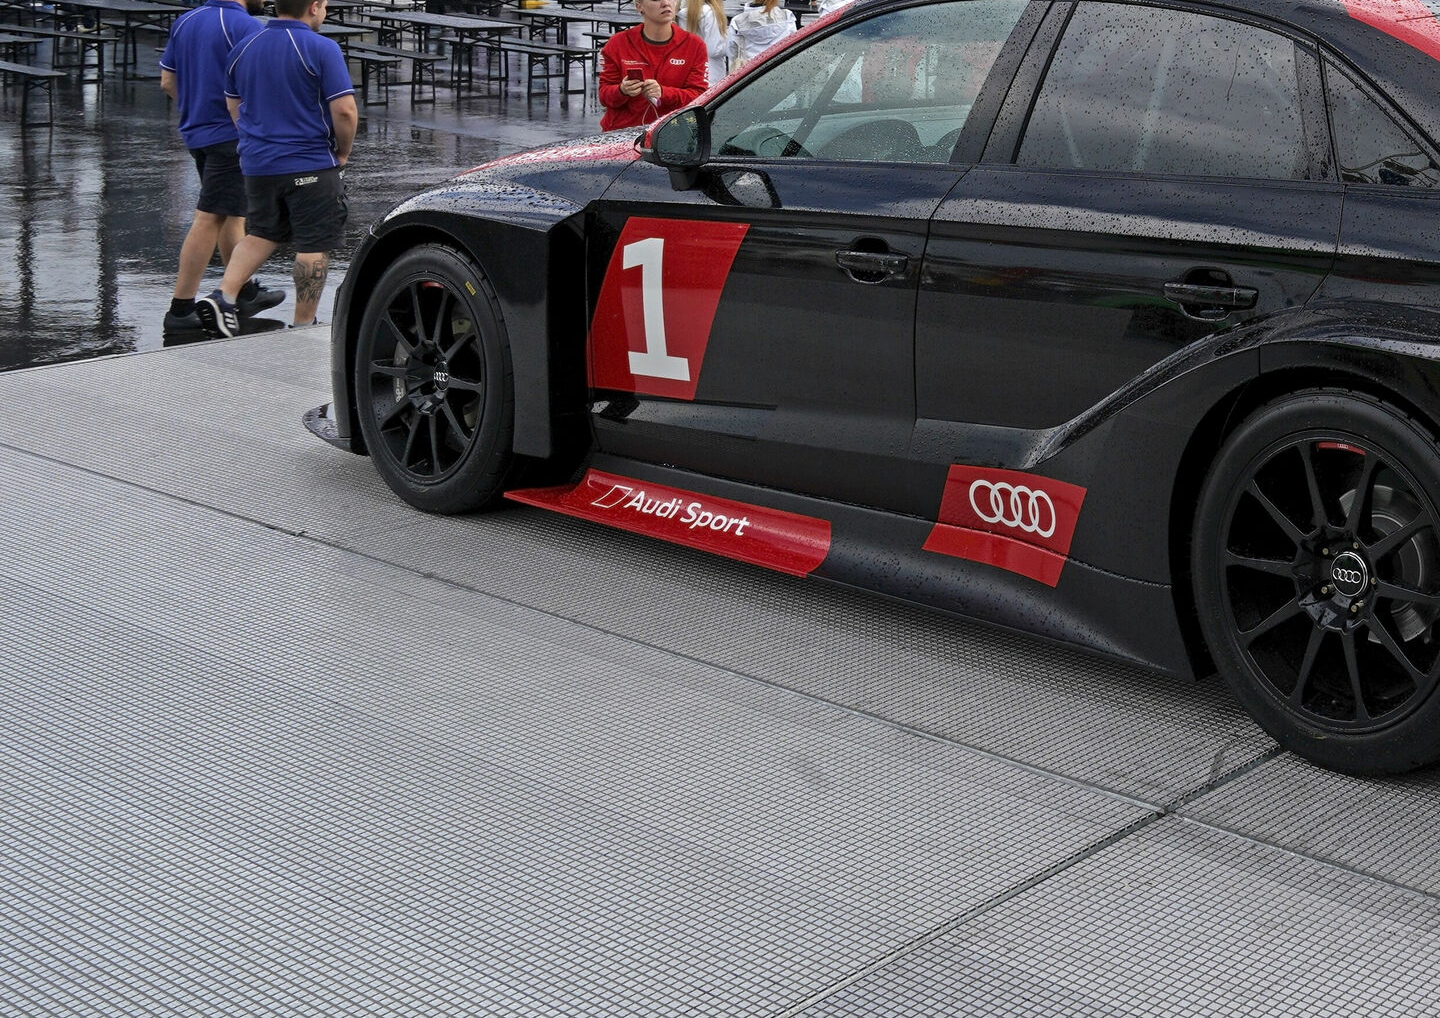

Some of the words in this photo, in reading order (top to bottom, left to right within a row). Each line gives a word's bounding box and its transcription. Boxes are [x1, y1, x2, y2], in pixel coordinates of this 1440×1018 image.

[622, 237, 691, 382] 1
[623, 490, 683, 519] Audi
[680, 502, 750, 536] Sport
